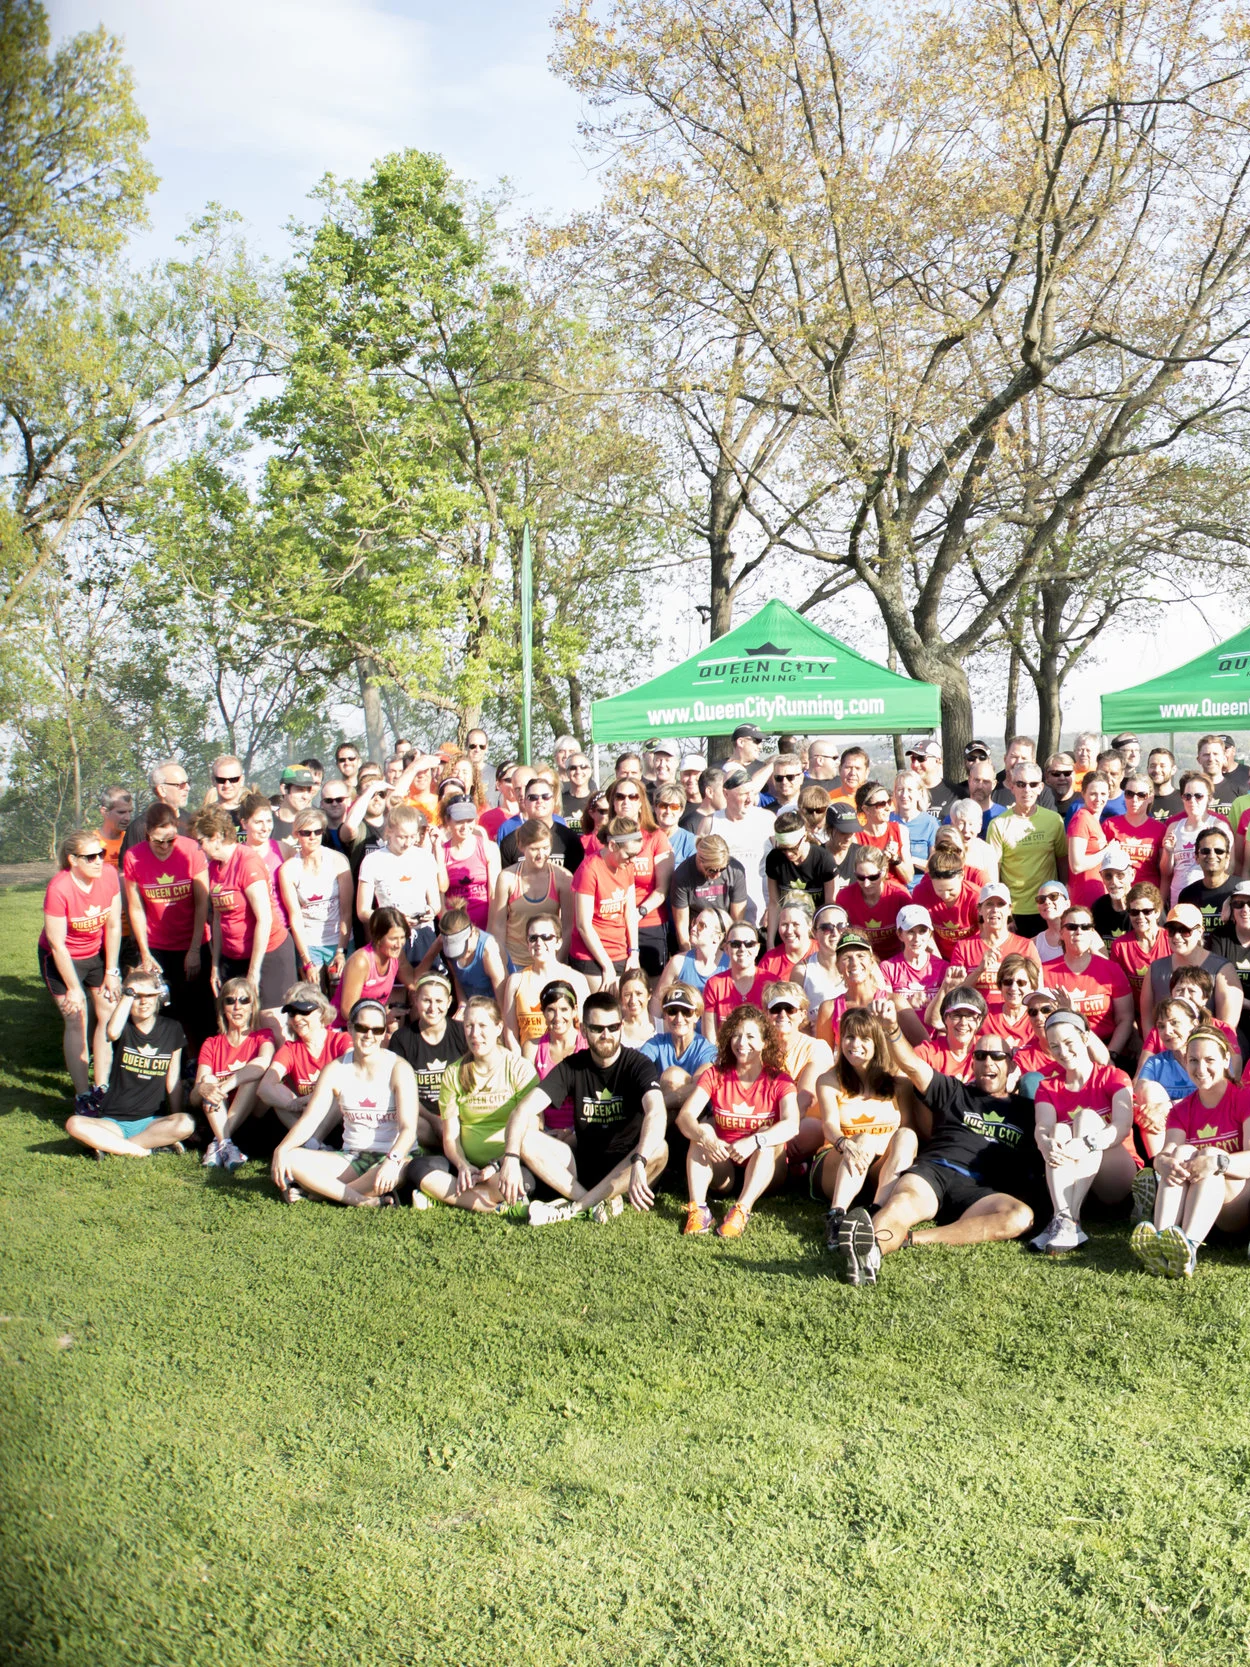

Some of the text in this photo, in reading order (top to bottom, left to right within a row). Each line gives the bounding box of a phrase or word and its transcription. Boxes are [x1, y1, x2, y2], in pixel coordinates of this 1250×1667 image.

[699, 661, 830, 678] QUEEN CITY
[730, 674, 797, 685] RUNNING
[647, 694, 885, 726] www.QueenCityRunning.com
[145, 889, 171, 899] QUEEN
[173, 885, 191, 896] CITY
[123, 1052, 170, 1070] QUEEN CITY
[715, 1115, 775, 1130] QUEEN CITY
[964, 1115, 1022, 1144] QUEEN CITY
